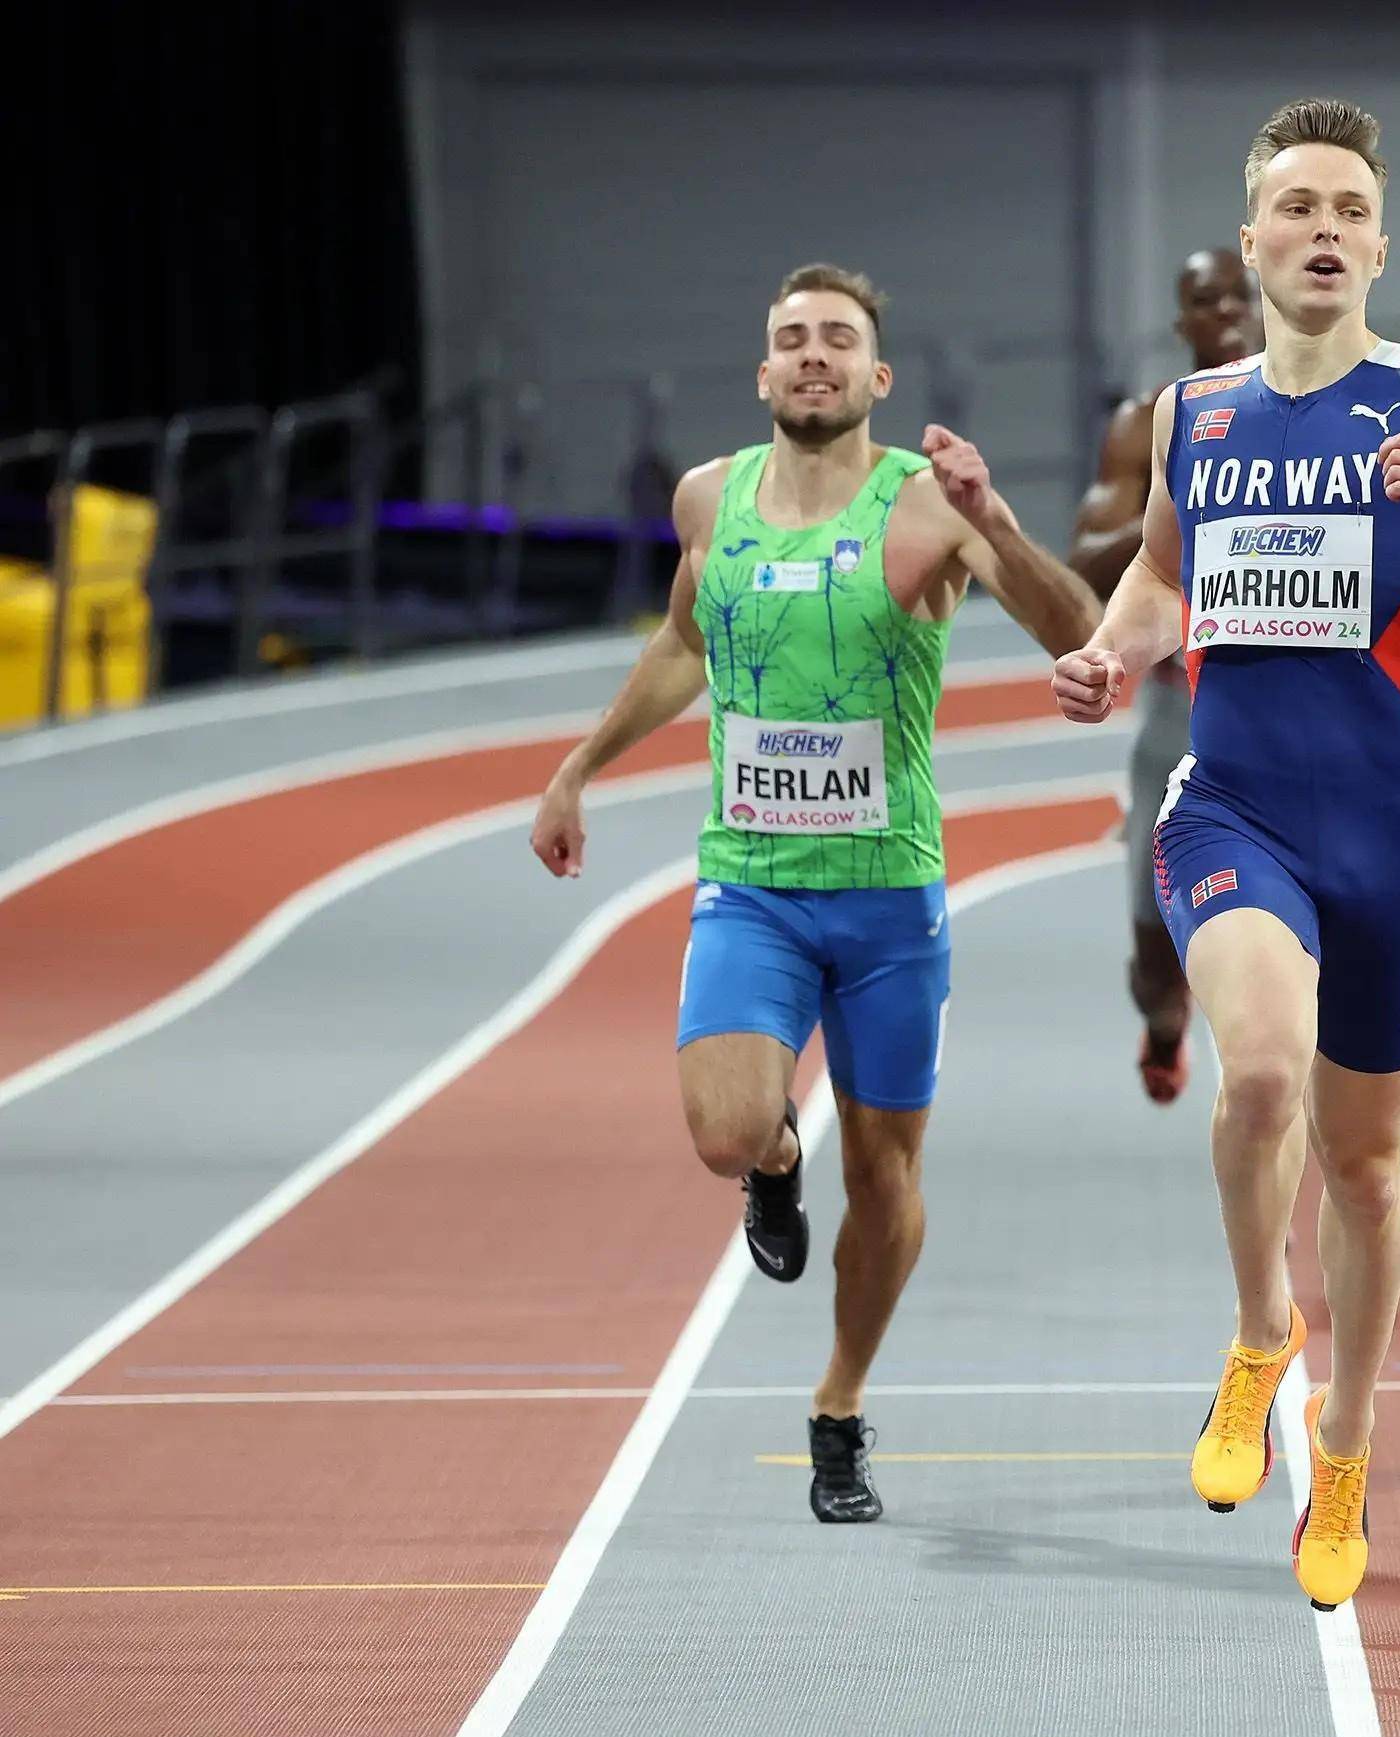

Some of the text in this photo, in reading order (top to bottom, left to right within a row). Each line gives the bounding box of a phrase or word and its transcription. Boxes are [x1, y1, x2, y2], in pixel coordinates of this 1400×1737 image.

[1187, 451, 1379, 510] NORWAY
[1229, 526, 1326, 556] HI-CHEW
[1200, 569, 1360, 612] WARHOLM
[1225, 619, 1361, 638] GLASGOW 24
[757, 731, 844, 758] HI-CHEW
[737, 763, 871, 801] FERLAN
[762, 809, 881, 826] GLASGOW 24
